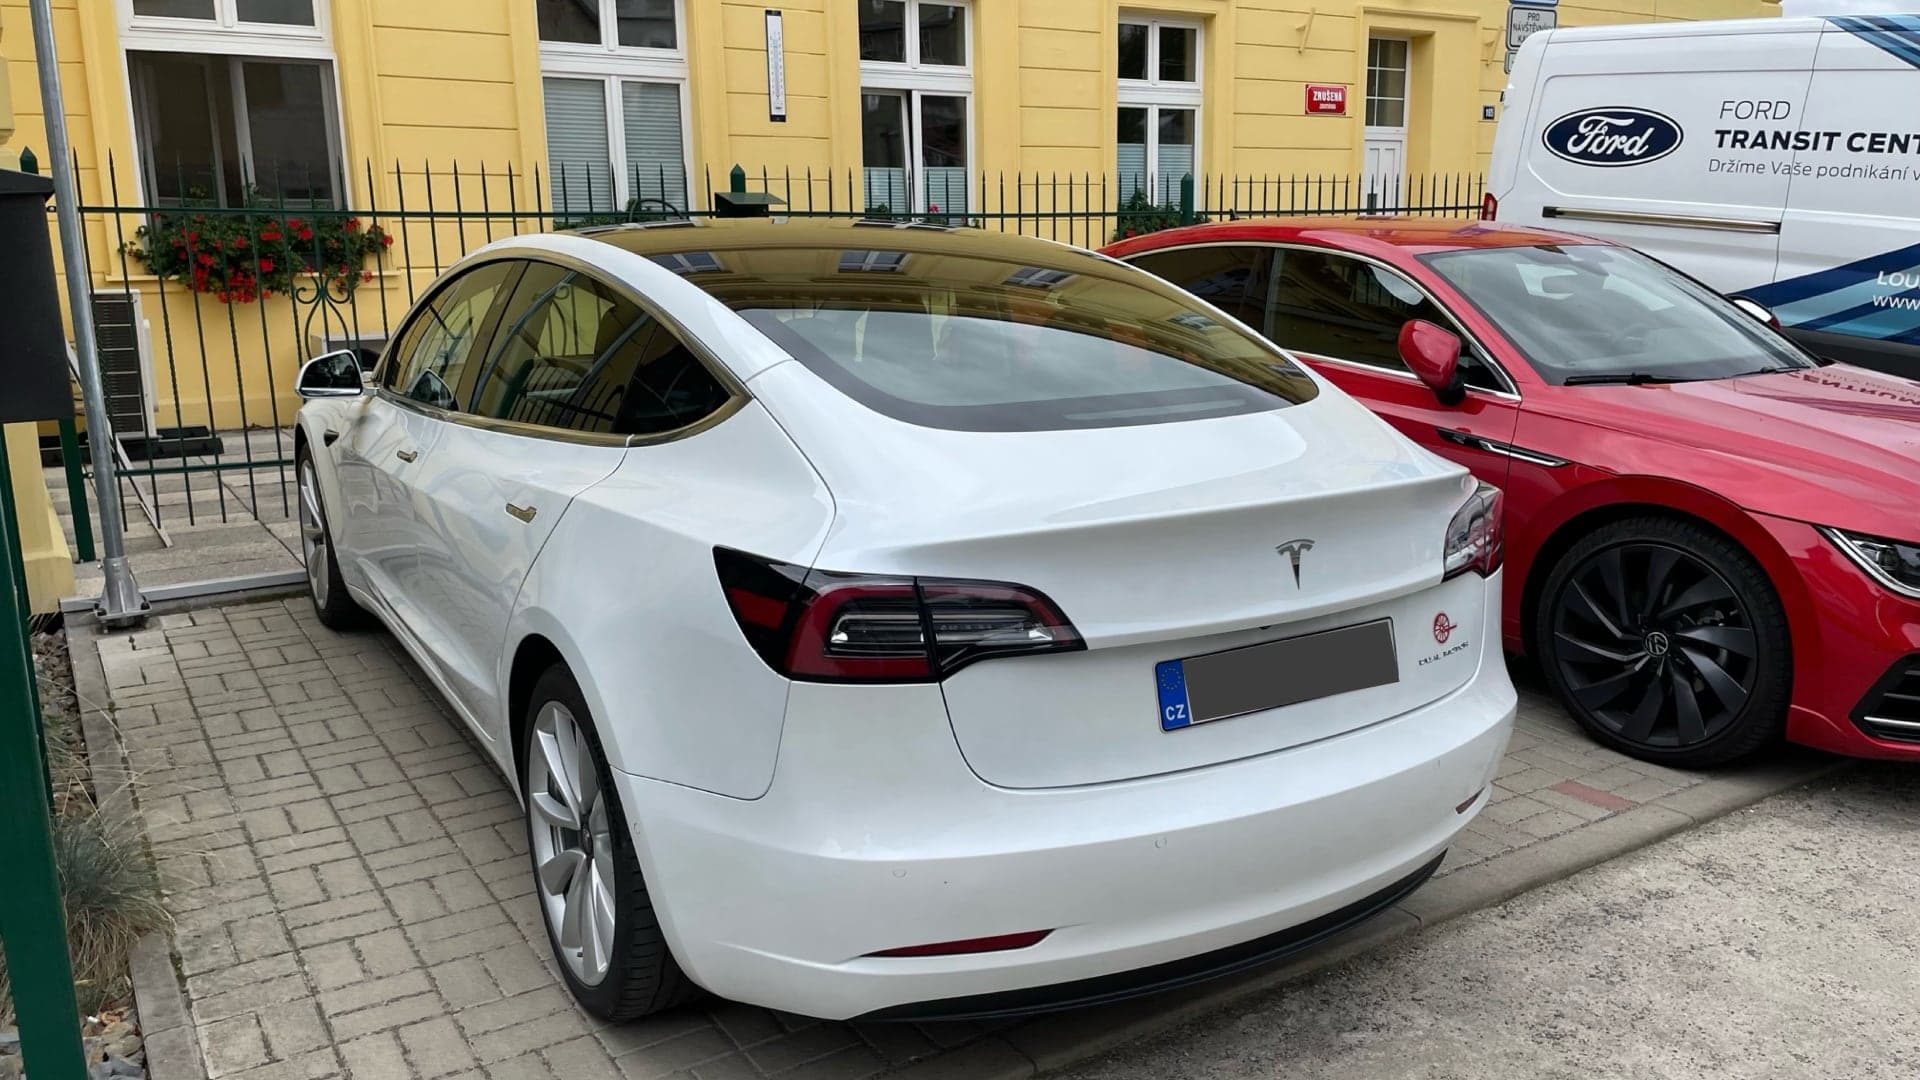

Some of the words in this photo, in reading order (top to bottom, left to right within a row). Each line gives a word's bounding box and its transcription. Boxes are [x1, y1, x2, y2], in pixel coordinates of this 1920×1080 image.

[1527, 12, 1540, 21] PRO
[1719, 100, 1791, 120] FORD
[1566, 115, 1656, 156] Ford
[1714, 129, 1842, 151] TRANSIT
[1708, 158, 1766, 174] Držíme
[1771, 160, 1812, 176] Vaše
[1816, 163, 1910, 181] podnikání
[1876, 270, 1920, 289] LOU
[1165, 703, 1187, 721] CZ
